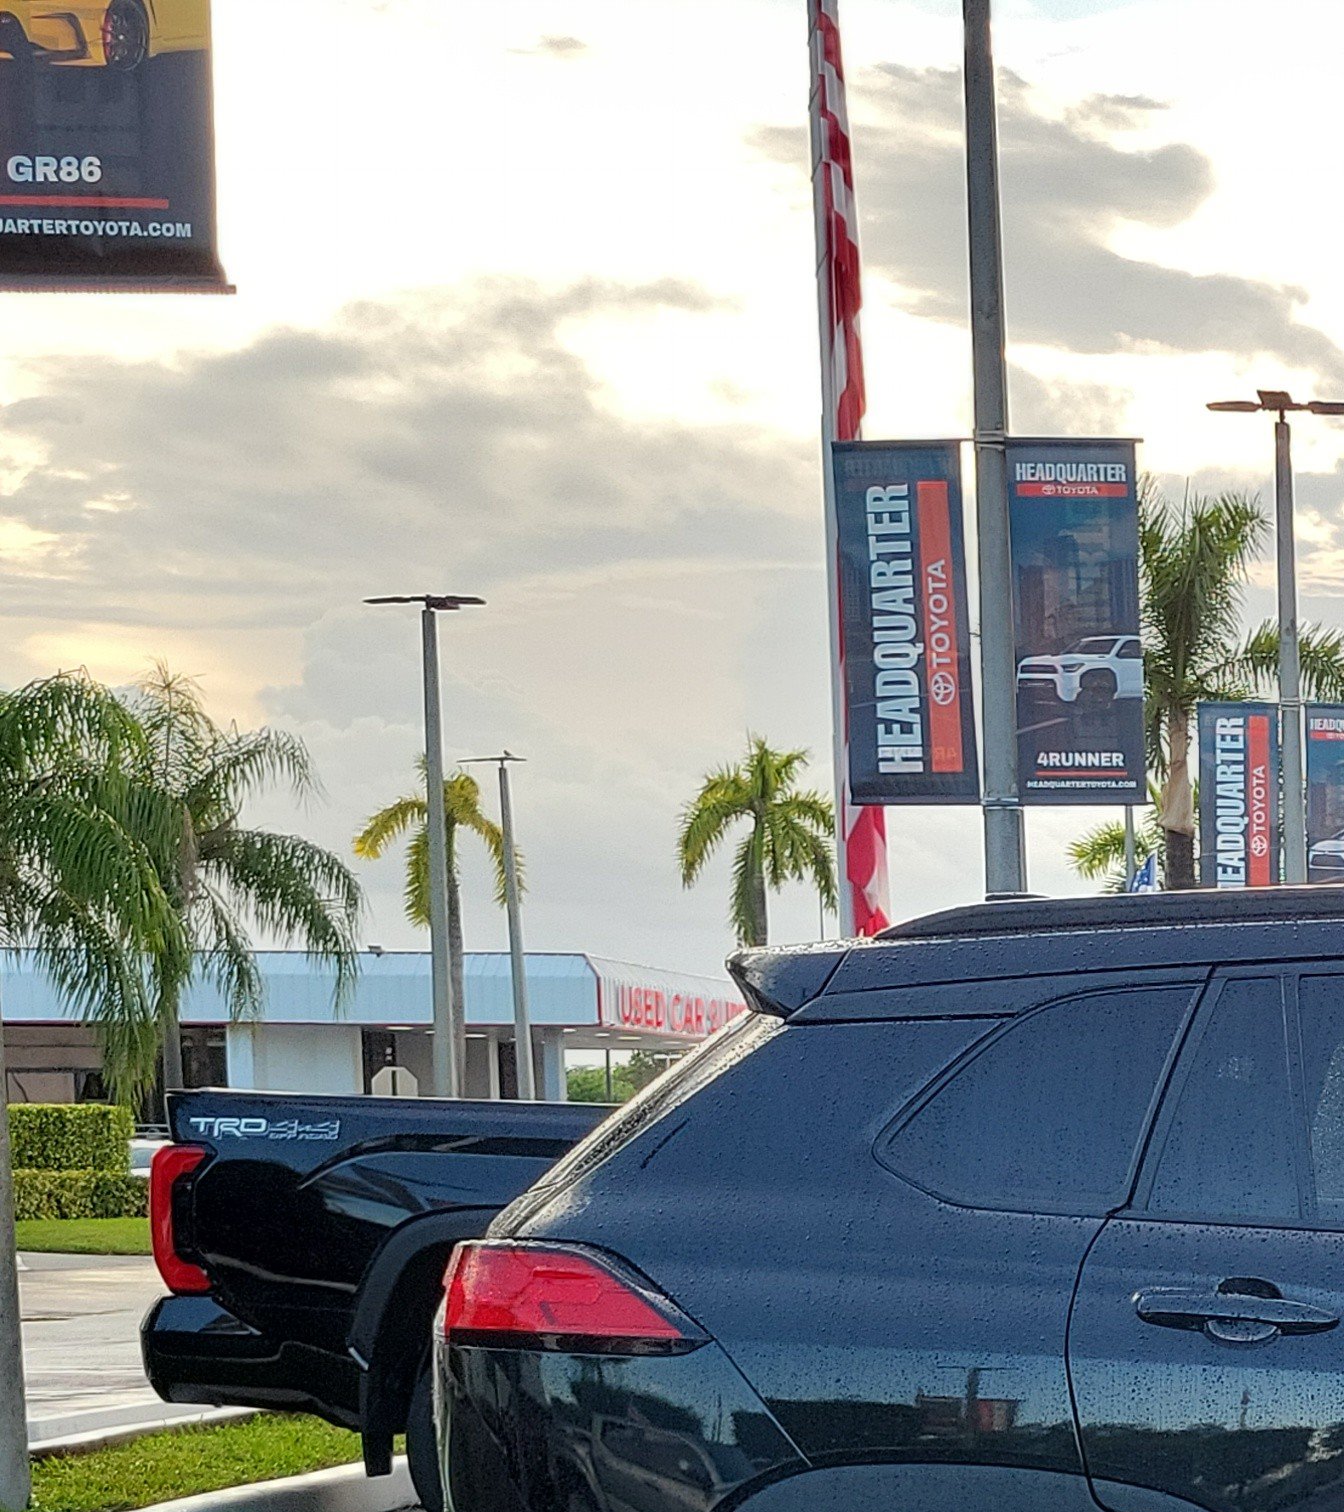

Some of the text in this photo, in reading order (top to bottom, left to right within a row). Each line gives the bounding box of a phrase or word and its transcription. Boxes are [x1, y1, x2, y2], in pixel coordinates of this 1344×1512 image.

[7, 156, 102, 183] GR86
[1015, 463, 1126, 483] HEADQUARTER
[1056, 485, 1099, 495] TOYOTA
[929, 559, 951, 666] TOYOTA
[866, 483, 925, 774] HEADQUARTER
[1036, 751, 1125, 767] 4RUNNER
[1253, 765, 1267, 835] TOYOTA
[617, 984, 666, 1028] USED
[669, 993, 705, 1034] CAR
[189, 1117, 268, 1140] TRD
